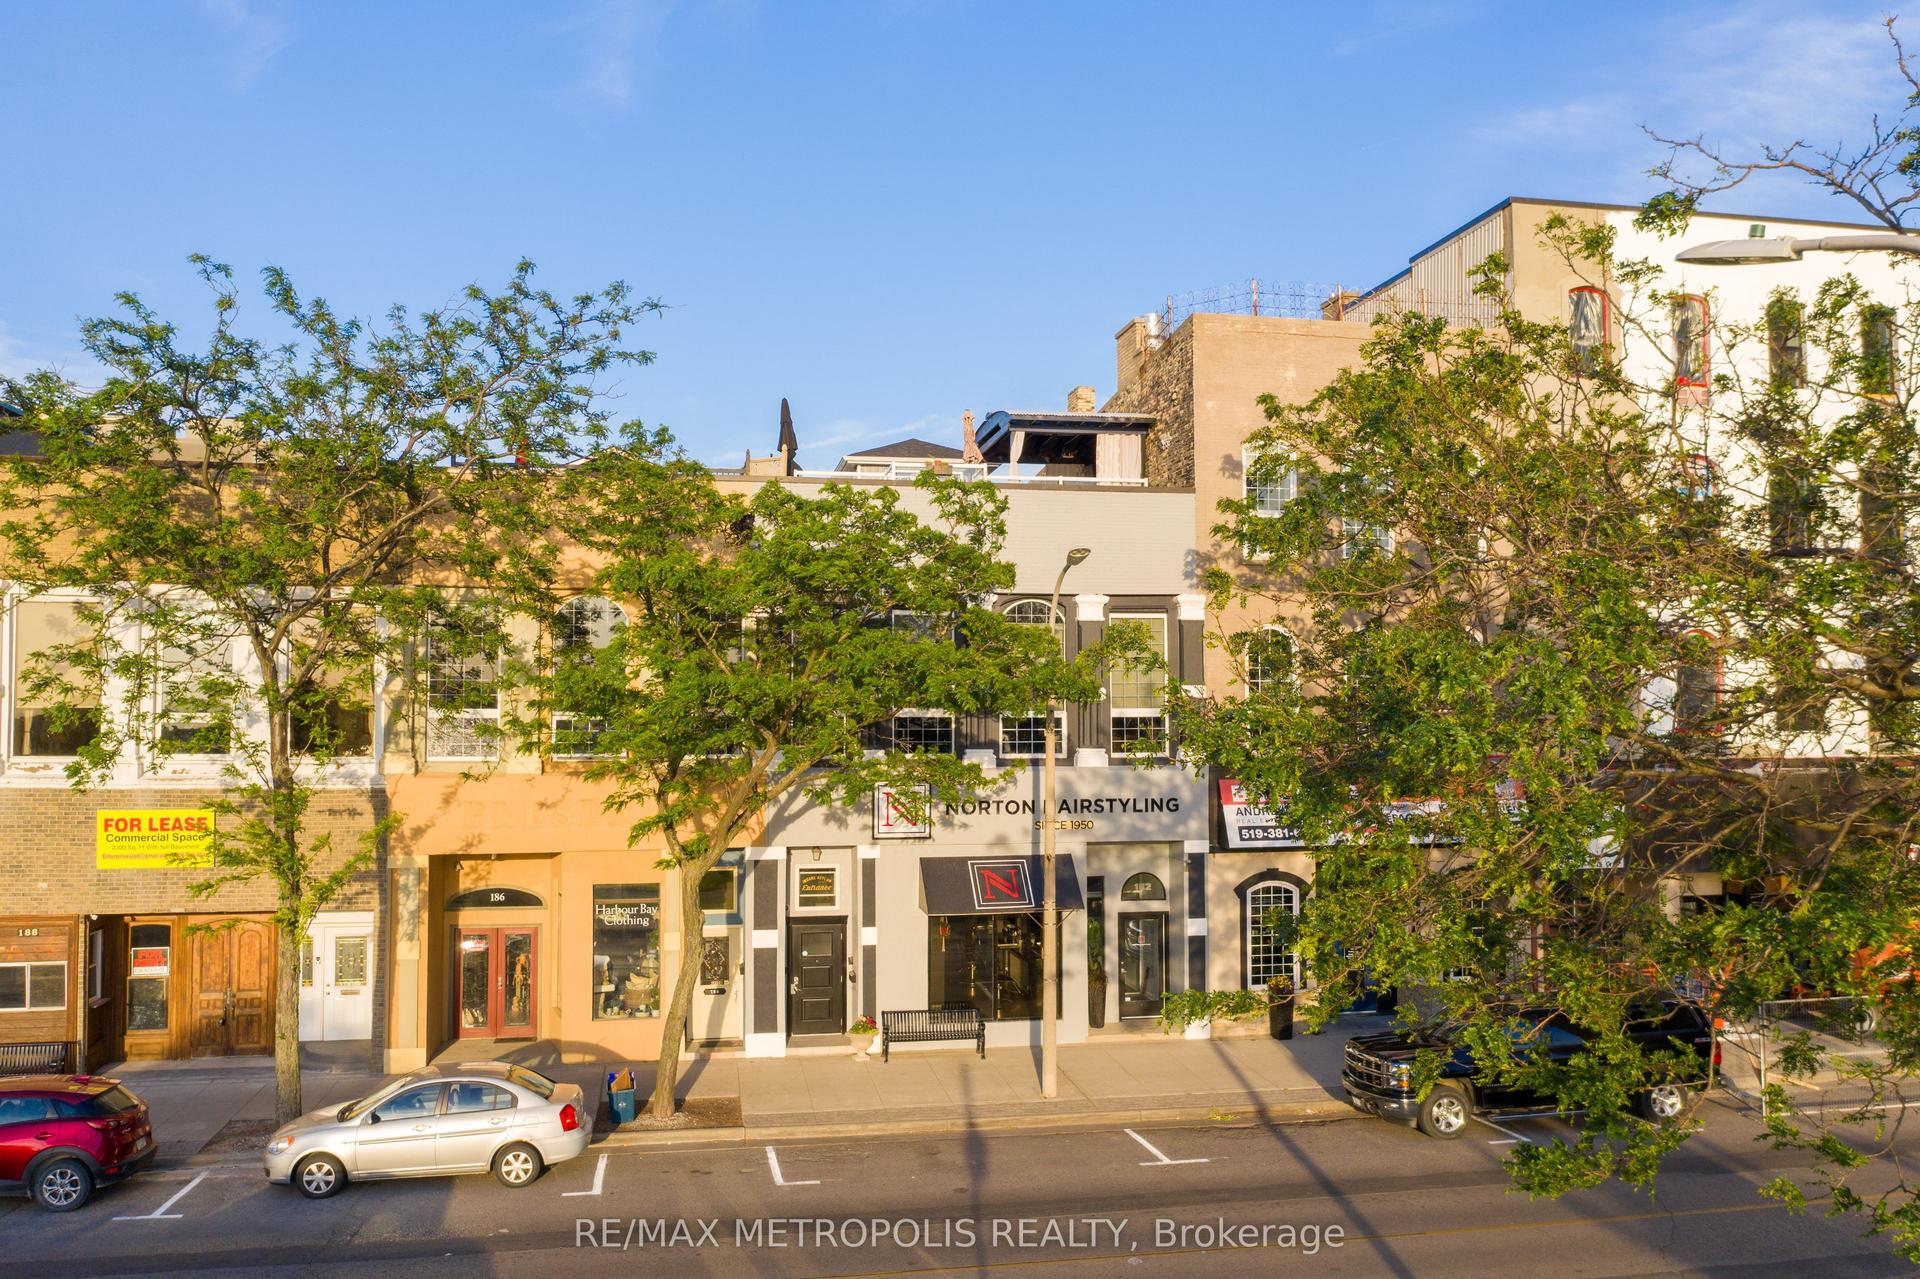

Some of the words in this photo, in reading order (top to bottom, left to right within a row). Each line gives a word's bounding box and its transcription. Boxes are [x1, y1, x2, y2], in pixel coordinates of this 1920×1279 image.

[945, 799, 1036, 815] NORTON
[1043, 797, 1180, 814] AIRSTYLING
[103, 817, 142, 833] FOR
[148, 816, 208, 832] LEASE
[1034, 820, 1068, 831] SICE
[1070, 820, 1094, 831] 1950
[105, 833, 169, 843] Commercial
[172, 832, 205, 844] Space
[978, 869, 1019, 899] N
[490, 892, 505, 902] 186
[595, 903, 639, 915] Harbour
[639, 903, 658, 916] Bay
[604, 914, 650, 927] Clothing
[18, 928, 38, 937] 188
